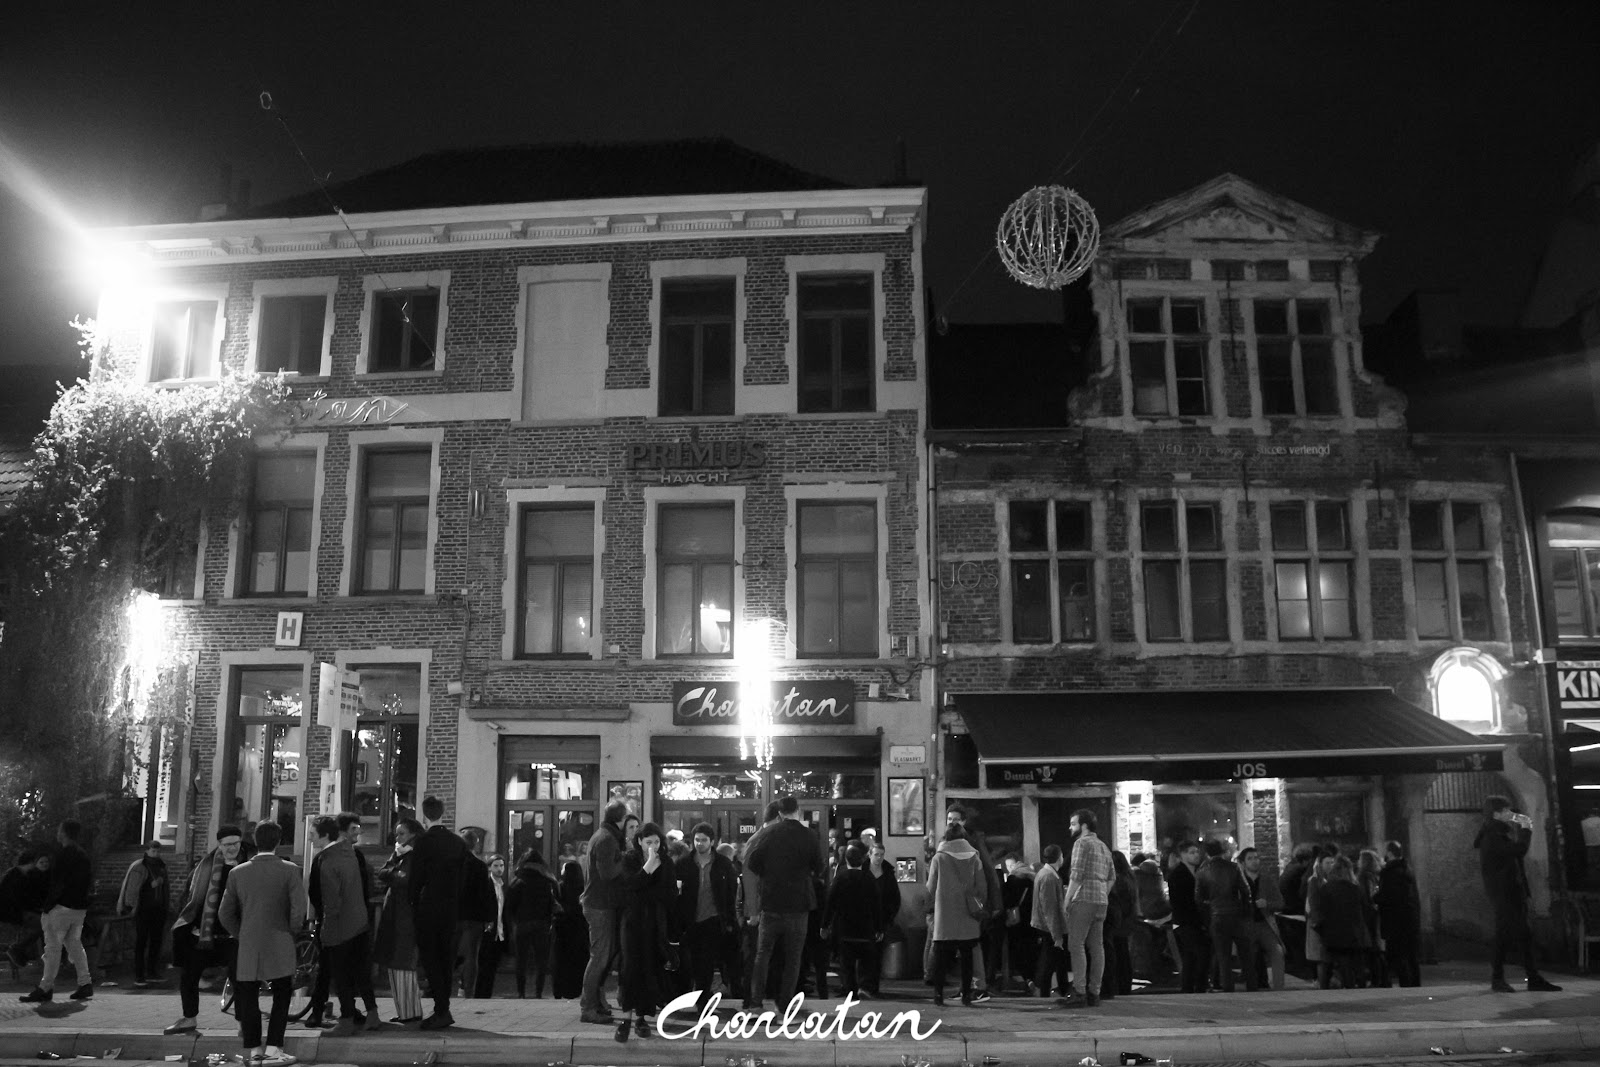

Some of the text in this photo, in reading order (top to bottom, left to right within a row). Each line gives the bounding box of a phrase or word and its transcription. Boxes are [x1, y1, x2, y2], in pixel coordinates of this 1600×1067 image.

[627, 440, 767, 468] PRIMUS
[1289, 444, 1330, 457] verlengd
[660, 472, 730, 483] HAACHT
[281, 618, 297, 640] H
[676, 686, 850, 718] Chatan
[1004, 770, 1034, 781] Duvel
[1233, 763, 1267, 778] JOS
